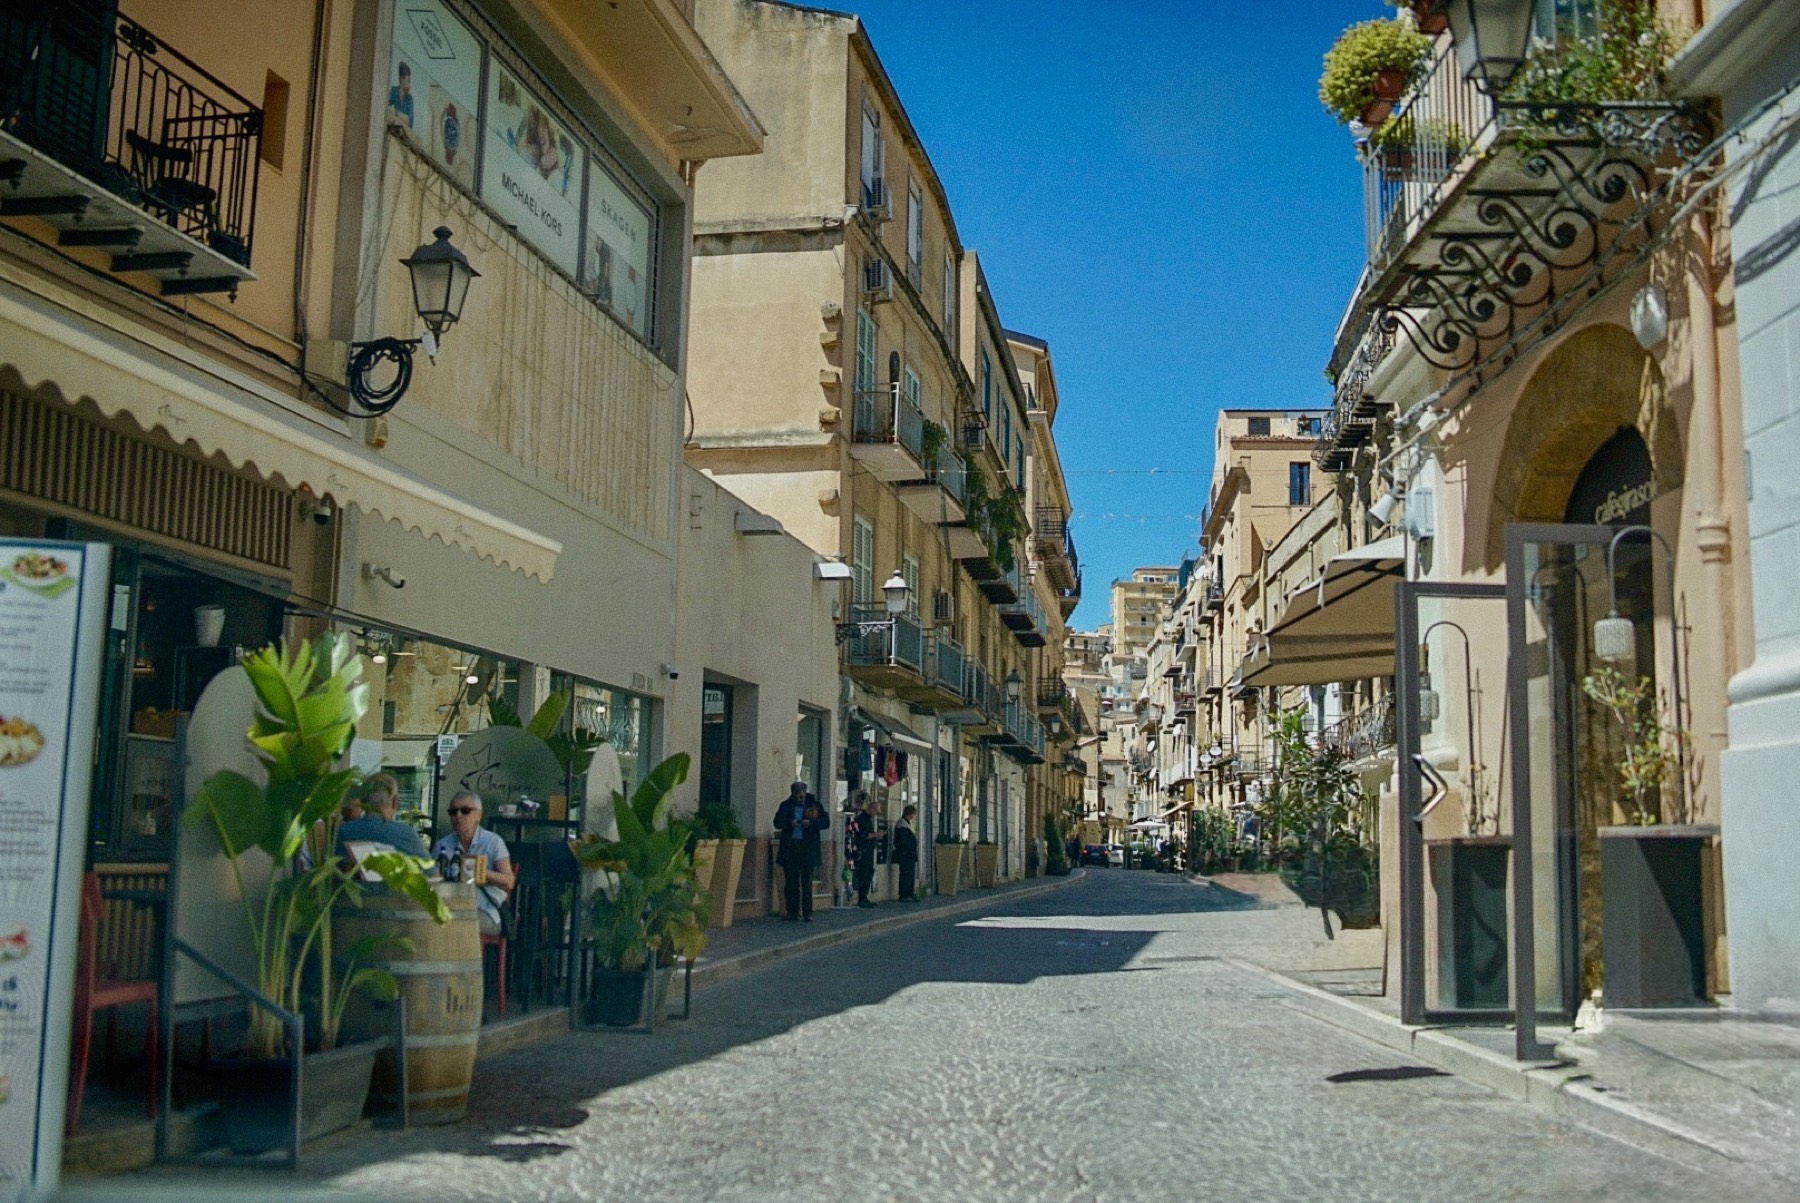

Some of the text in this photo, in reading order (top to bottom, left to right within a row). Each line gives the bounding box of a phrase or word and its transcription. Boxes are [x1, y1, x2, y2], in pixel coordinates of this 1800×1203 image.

[501, 172, 562, 237] MICHAEL KORS
[601, 199, 636, 242] SKAGEN
